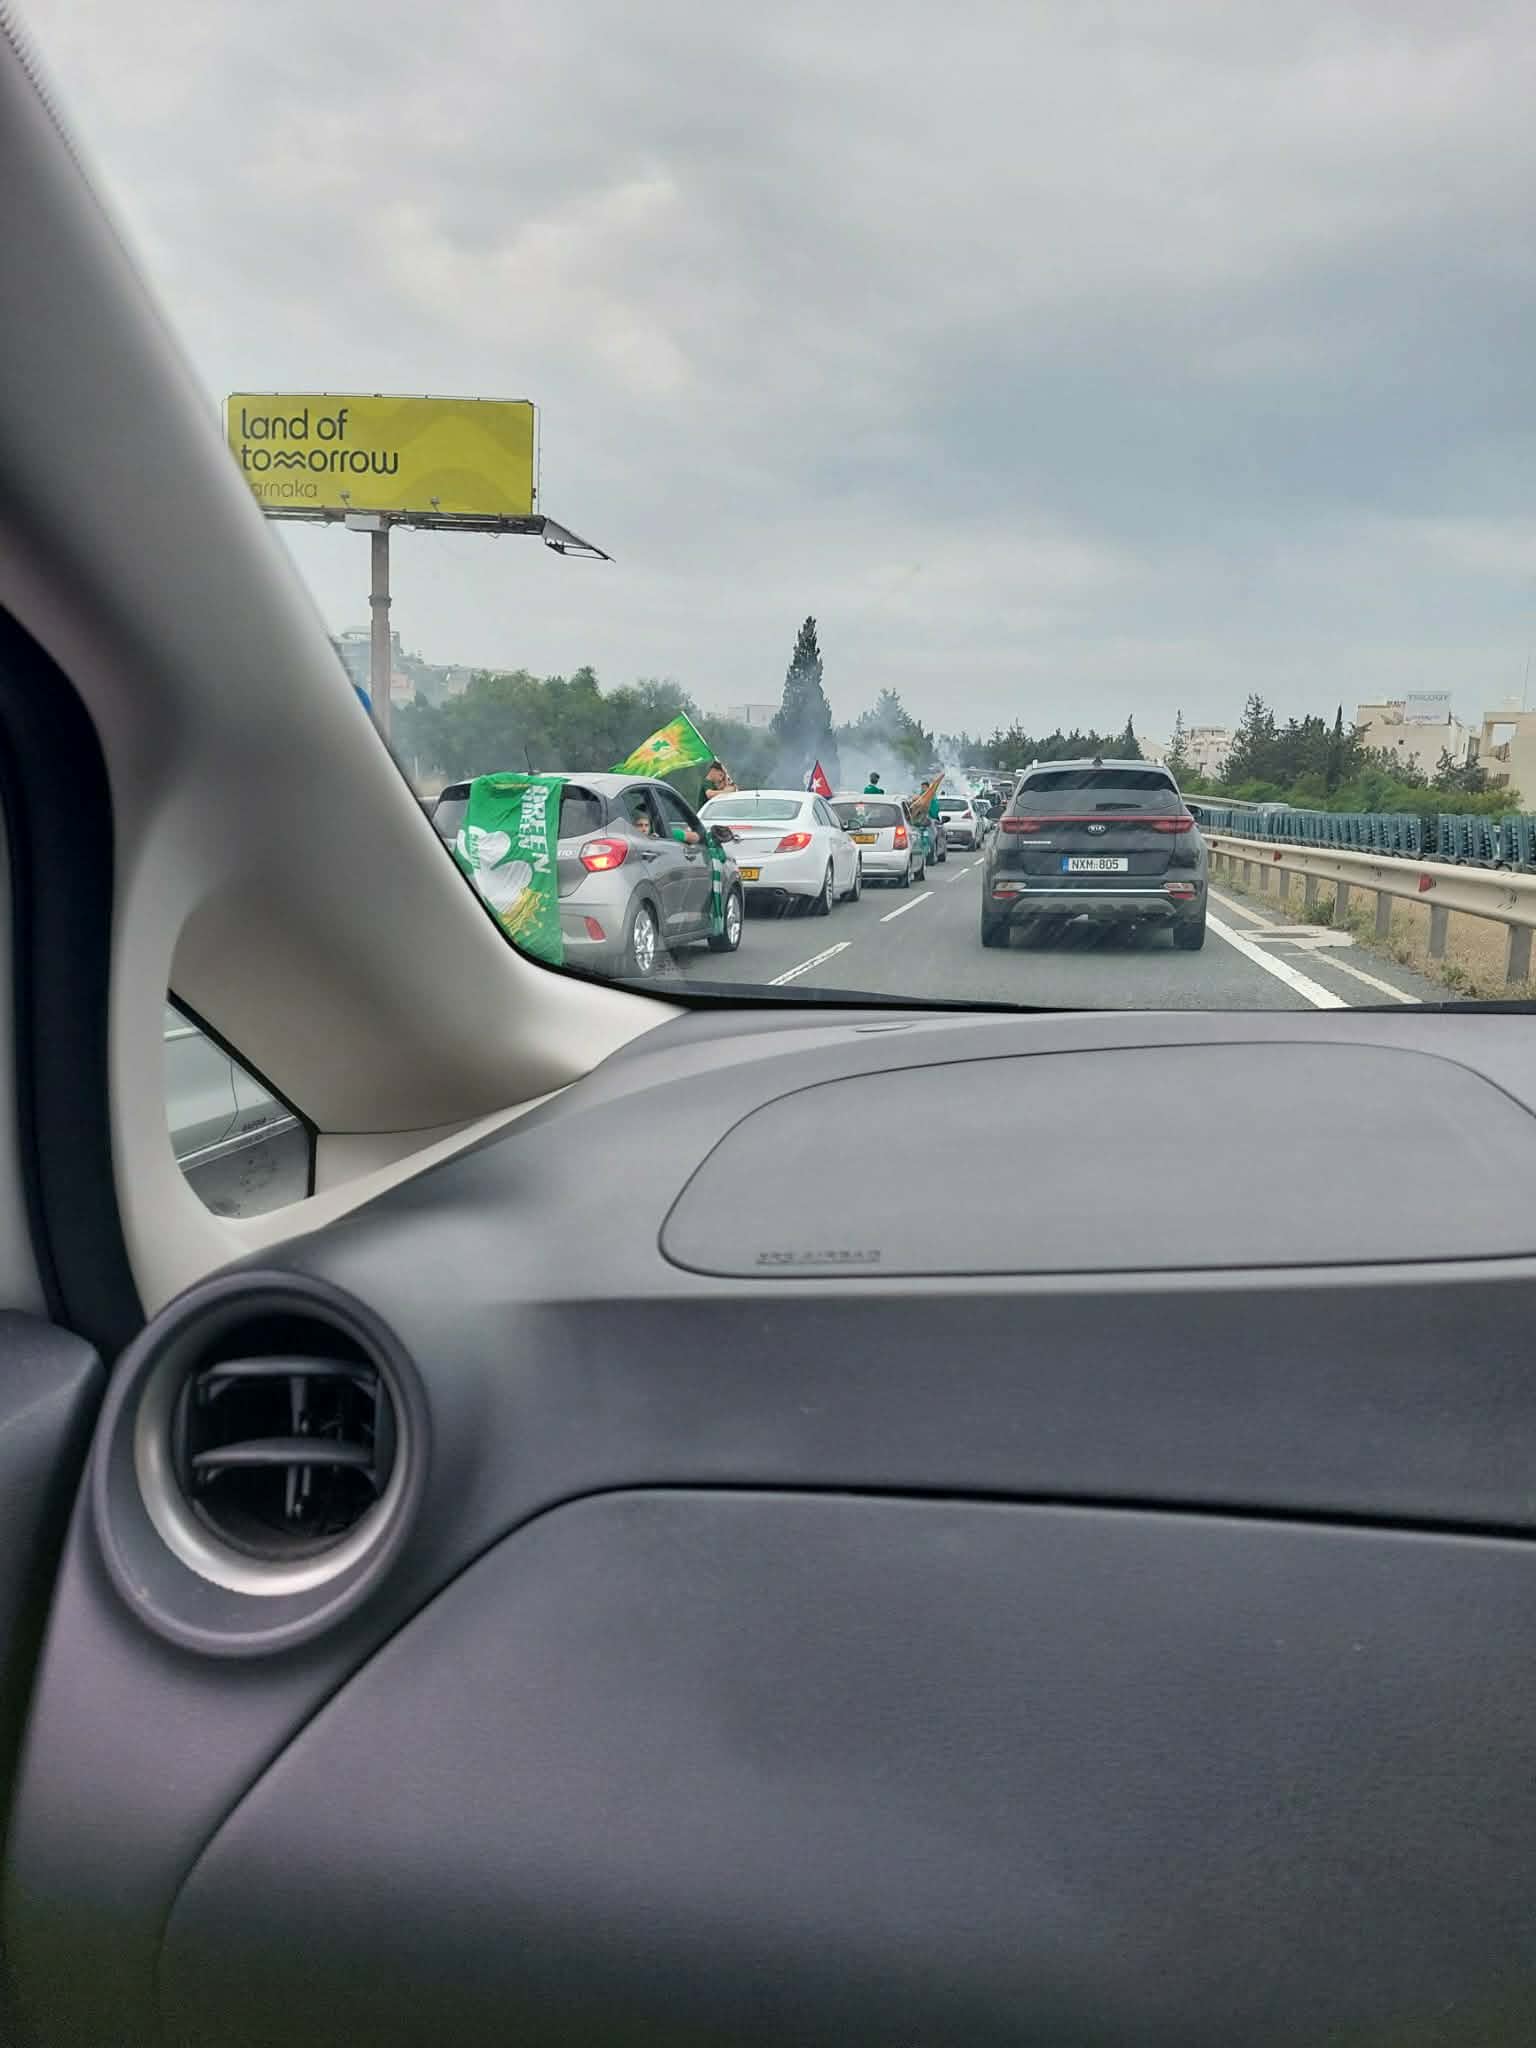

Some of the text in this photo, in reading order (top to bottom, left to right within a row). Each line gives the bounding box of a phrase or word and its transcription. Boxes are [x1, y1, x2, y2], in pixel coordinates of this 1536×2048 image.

[241, 408, 349, 441] land of
[250, 479, 318, 498] arnaka
[1071, 859, 1119, 870] NXM 805
